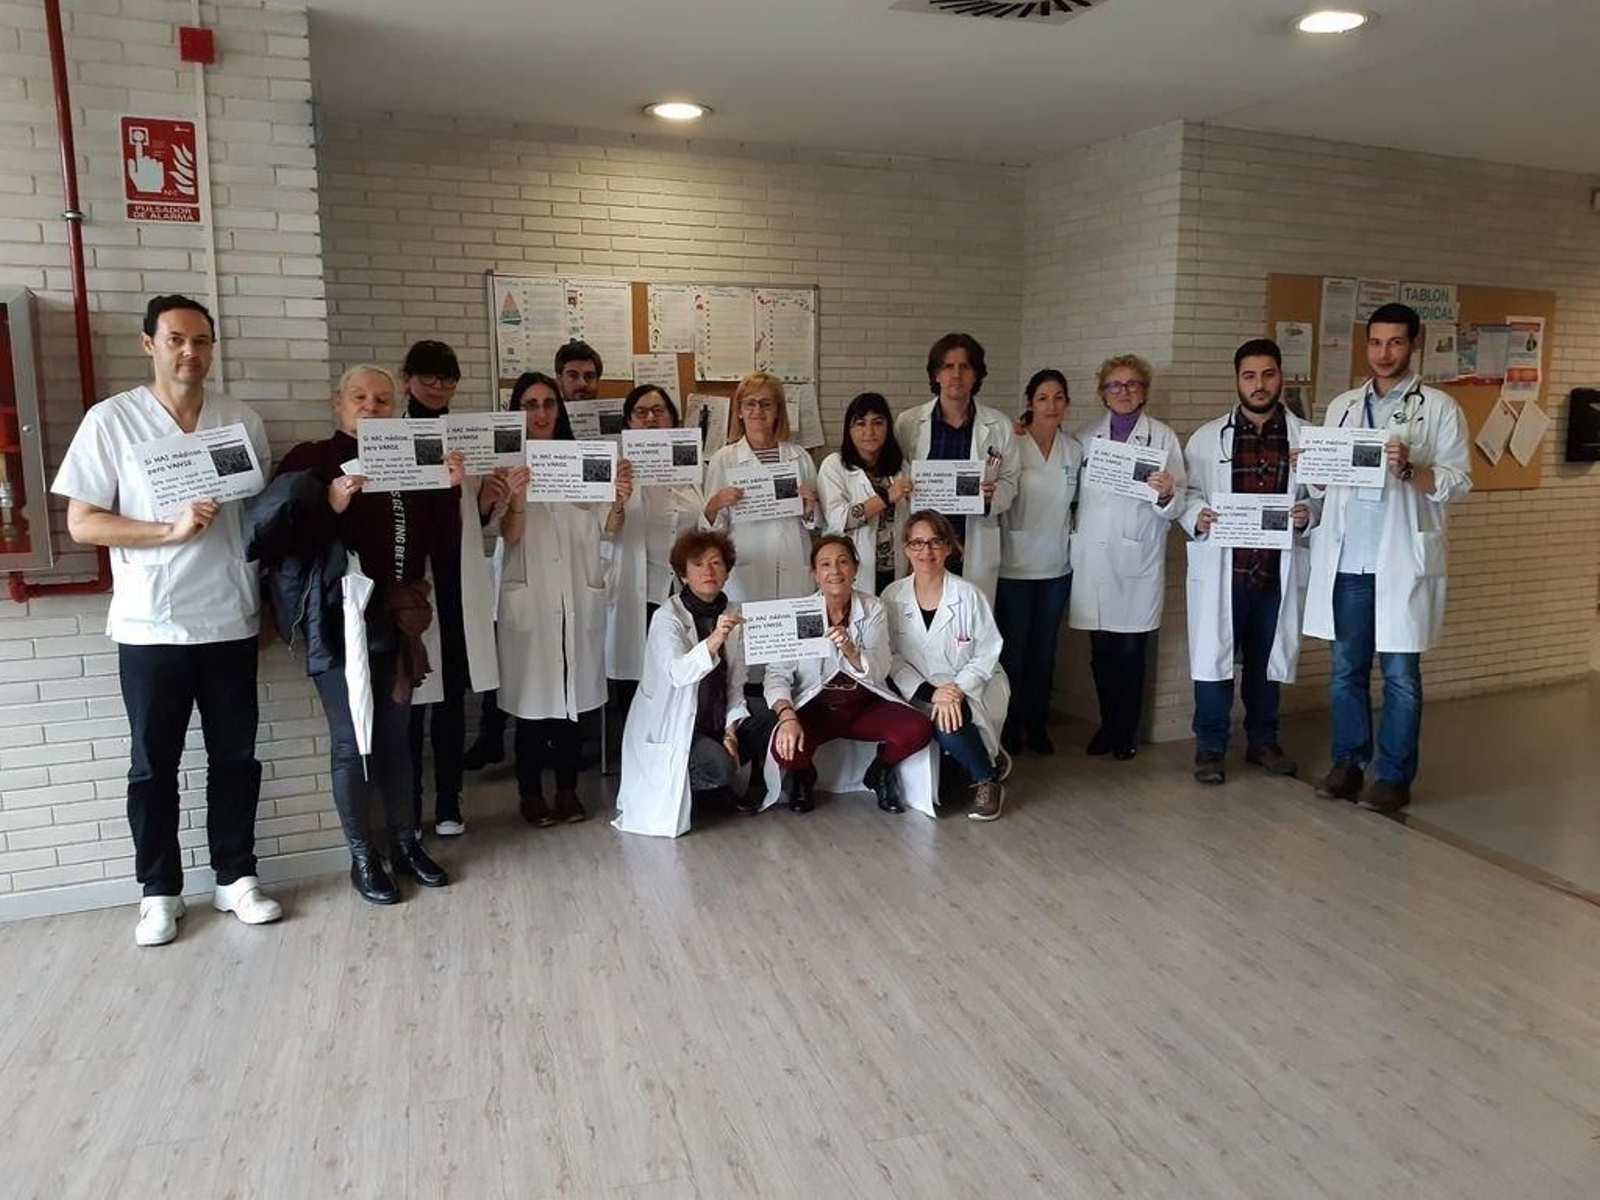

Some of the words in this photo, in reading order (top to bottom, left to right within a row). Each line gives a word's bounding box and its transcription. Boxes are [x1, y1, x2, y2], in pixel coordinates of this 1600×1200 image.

[135, 205, 191, 214] PULSADOR
[150, 212, 194, 221] ALARMA
[1405, 287, 1449, 302] TABLON
[147, 464, 166, 476] pero
[391, 499, 406, 545] GETTING
